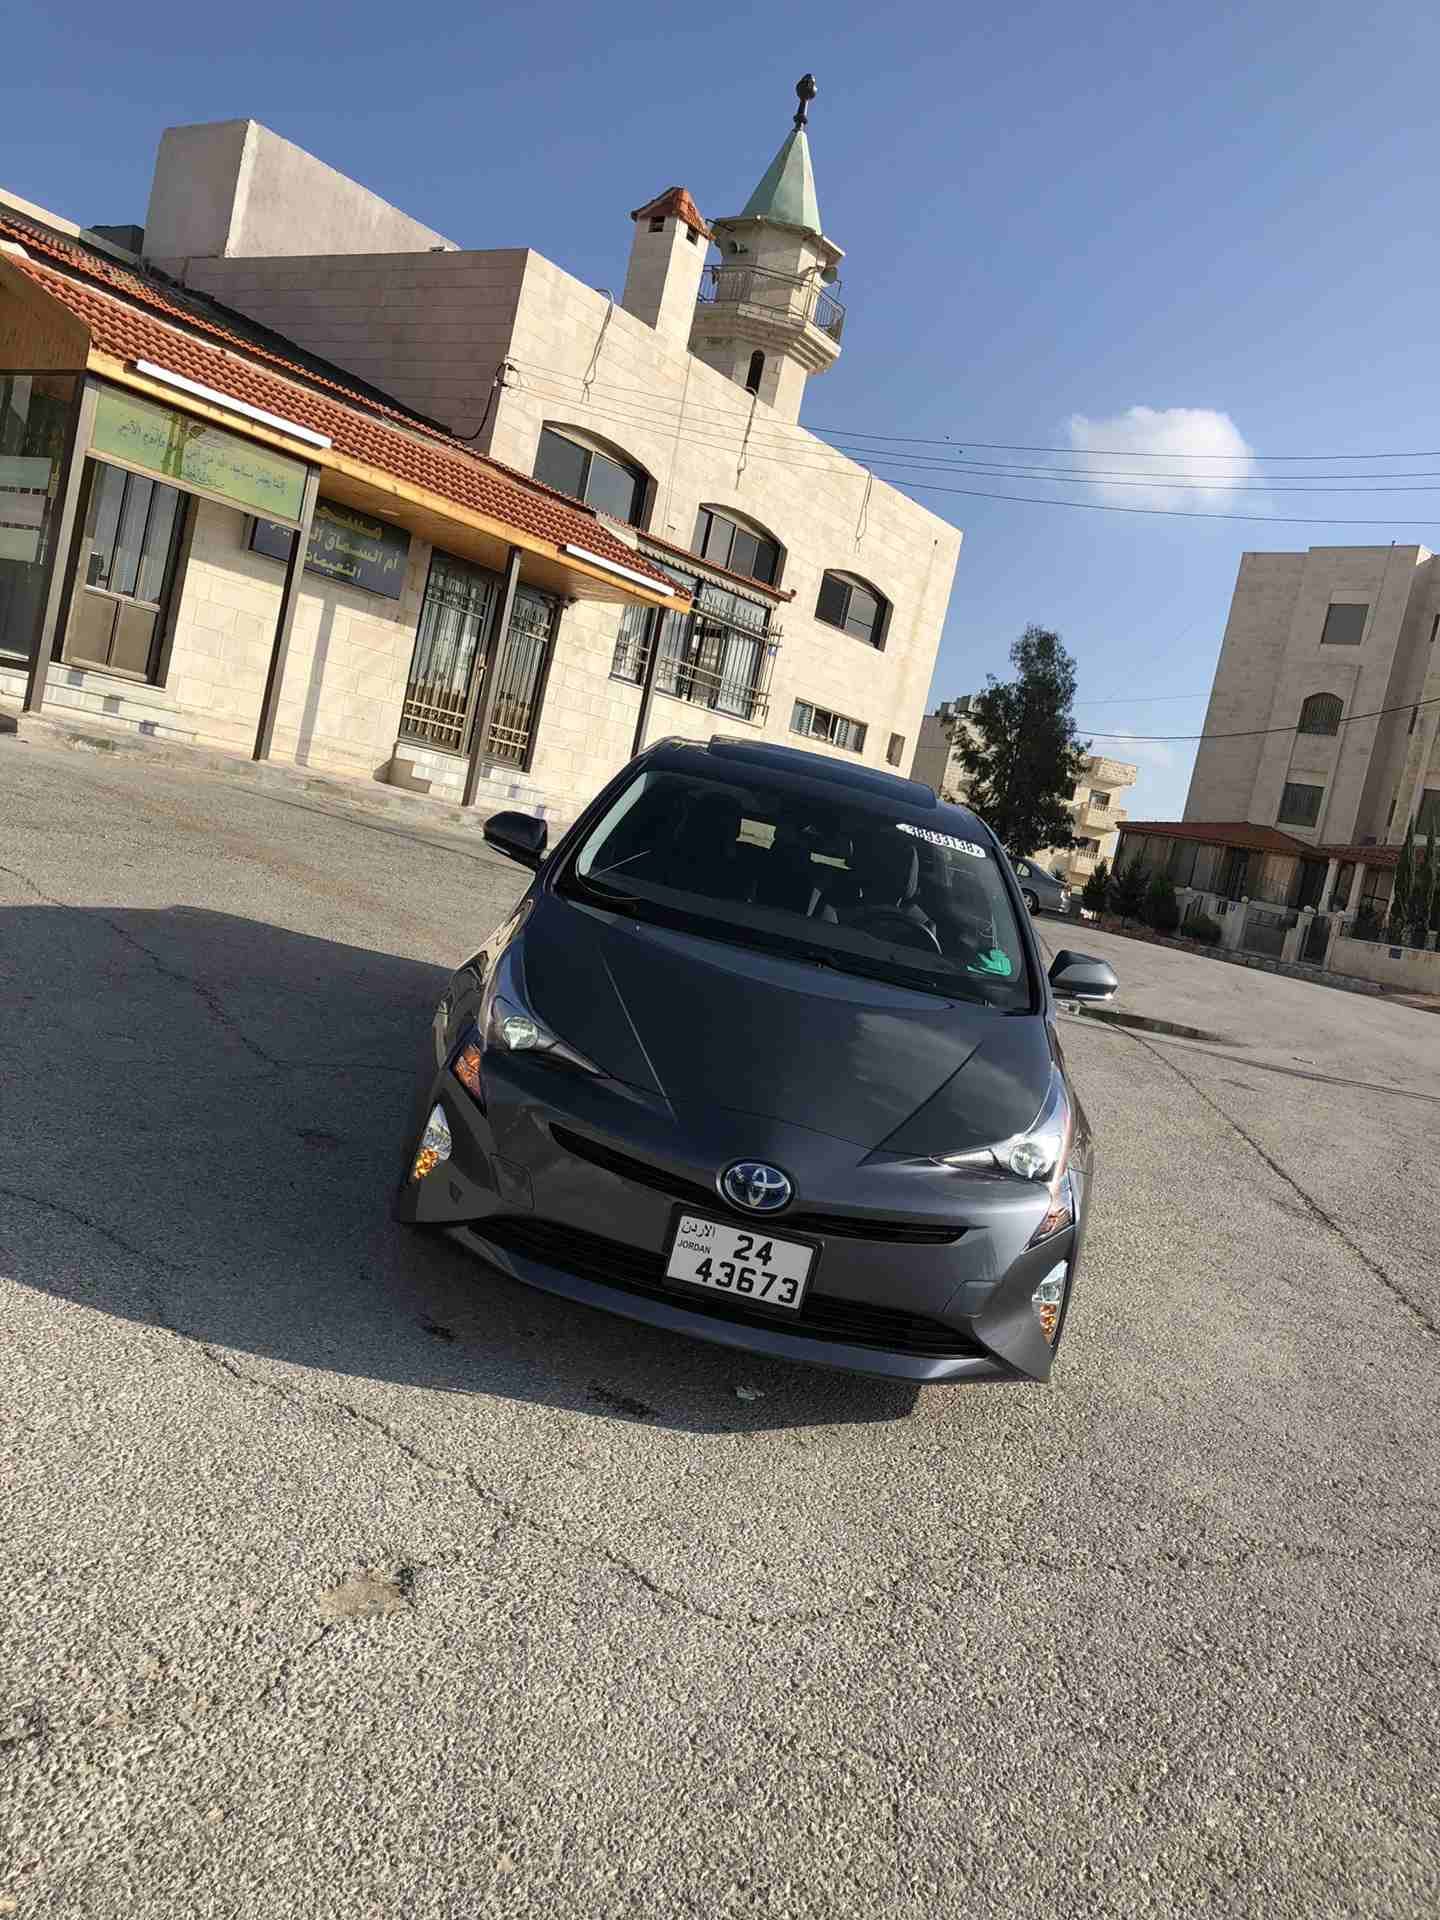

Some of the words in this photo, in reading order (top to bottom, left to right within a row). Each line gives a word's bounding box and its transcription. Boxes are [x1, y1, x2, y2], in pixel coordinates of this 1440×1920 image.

[677, 1239, 712, 1255] JORDAN
[733, 1233, 775, 1267] 24
[695, 1257, 800, 1304] 43673
